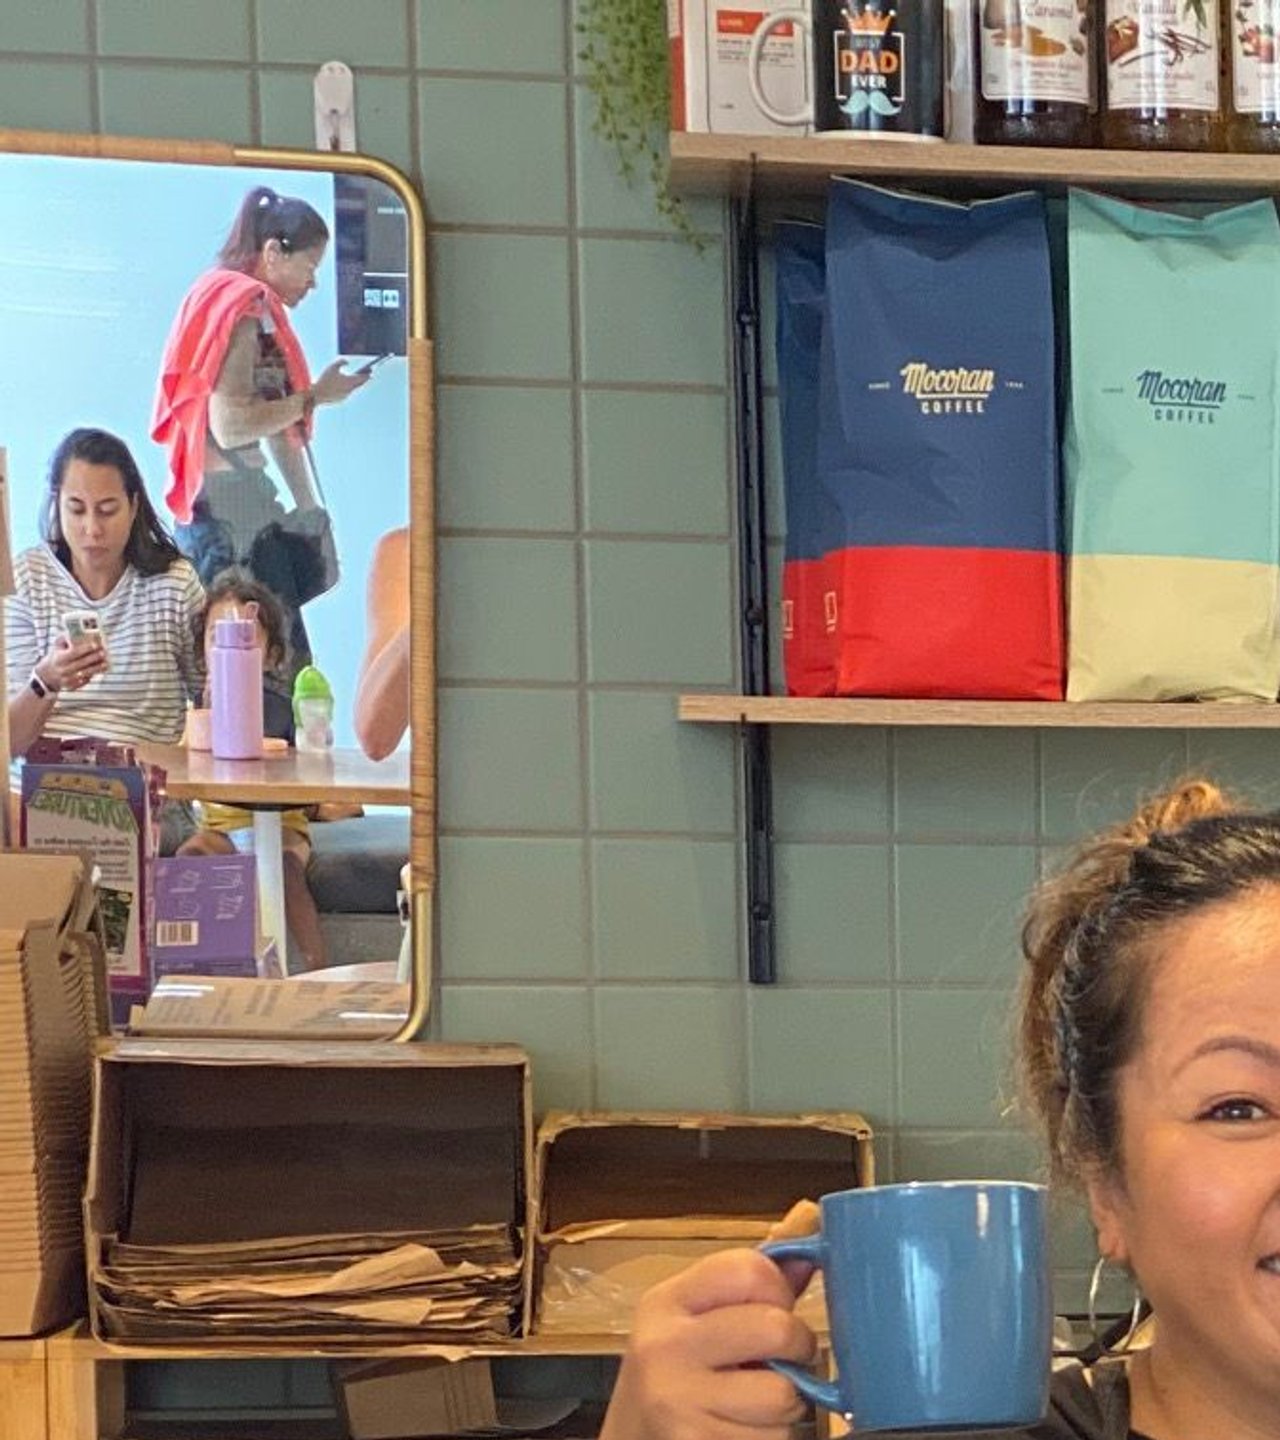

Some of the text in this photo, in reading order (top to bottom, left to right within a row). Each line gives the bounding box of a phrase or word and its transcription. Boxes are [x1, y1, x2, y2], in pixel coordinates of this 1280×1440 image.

[839, 49, 899, 74] DAD
[851, 75, 887, 88] EVER
[900, 362, 995, 399] Mocopan
[1136, 369, 1227, 409] Mocopan
[921, 400, 985, 414] COFFEE
[1154, 409, 1215, 423] COFFEE
